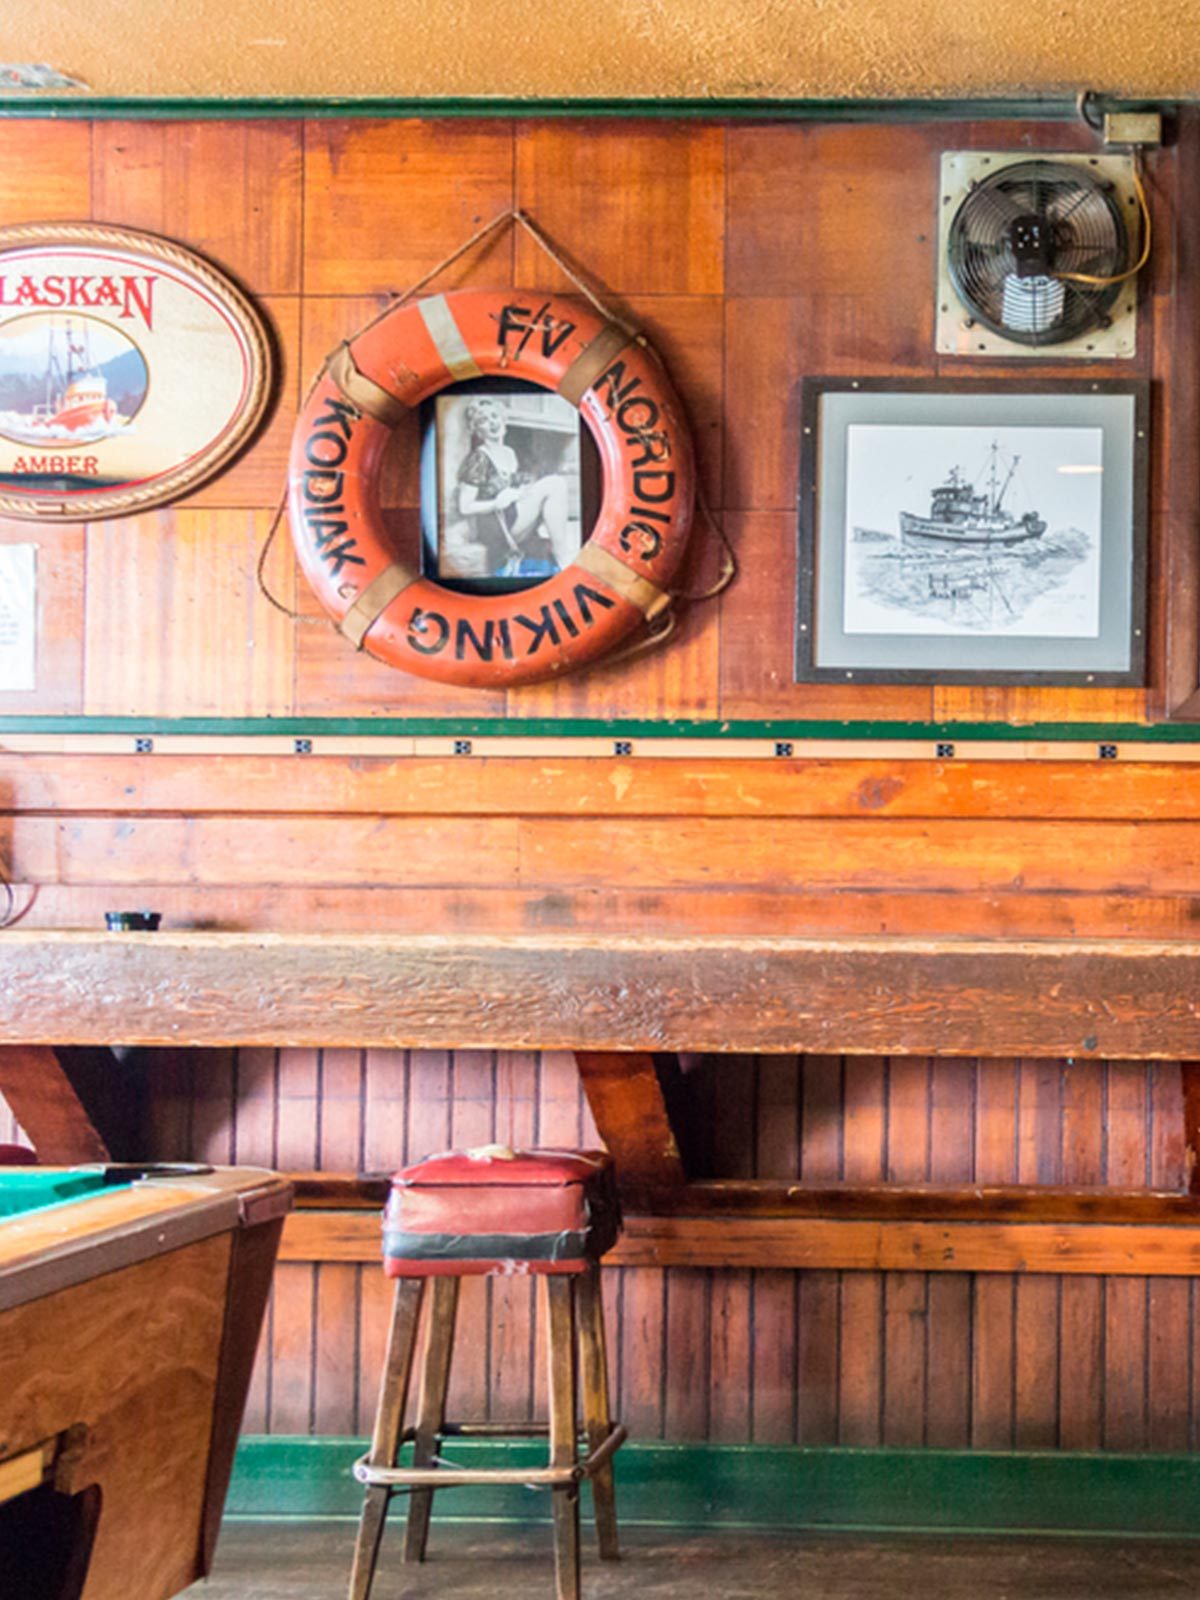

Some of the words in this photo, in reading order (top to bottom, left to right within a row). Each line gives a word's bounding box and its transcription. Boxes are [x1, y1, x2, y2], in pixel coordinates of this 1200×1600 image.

[498, 302, 576, 359] F/V
[12, 456, 99, 475] AMBER
[301, 397, 366, 578] KODIAK
[593, 360, 675, 562] NORDIC
[407, 583, 616, 662] VIKING
